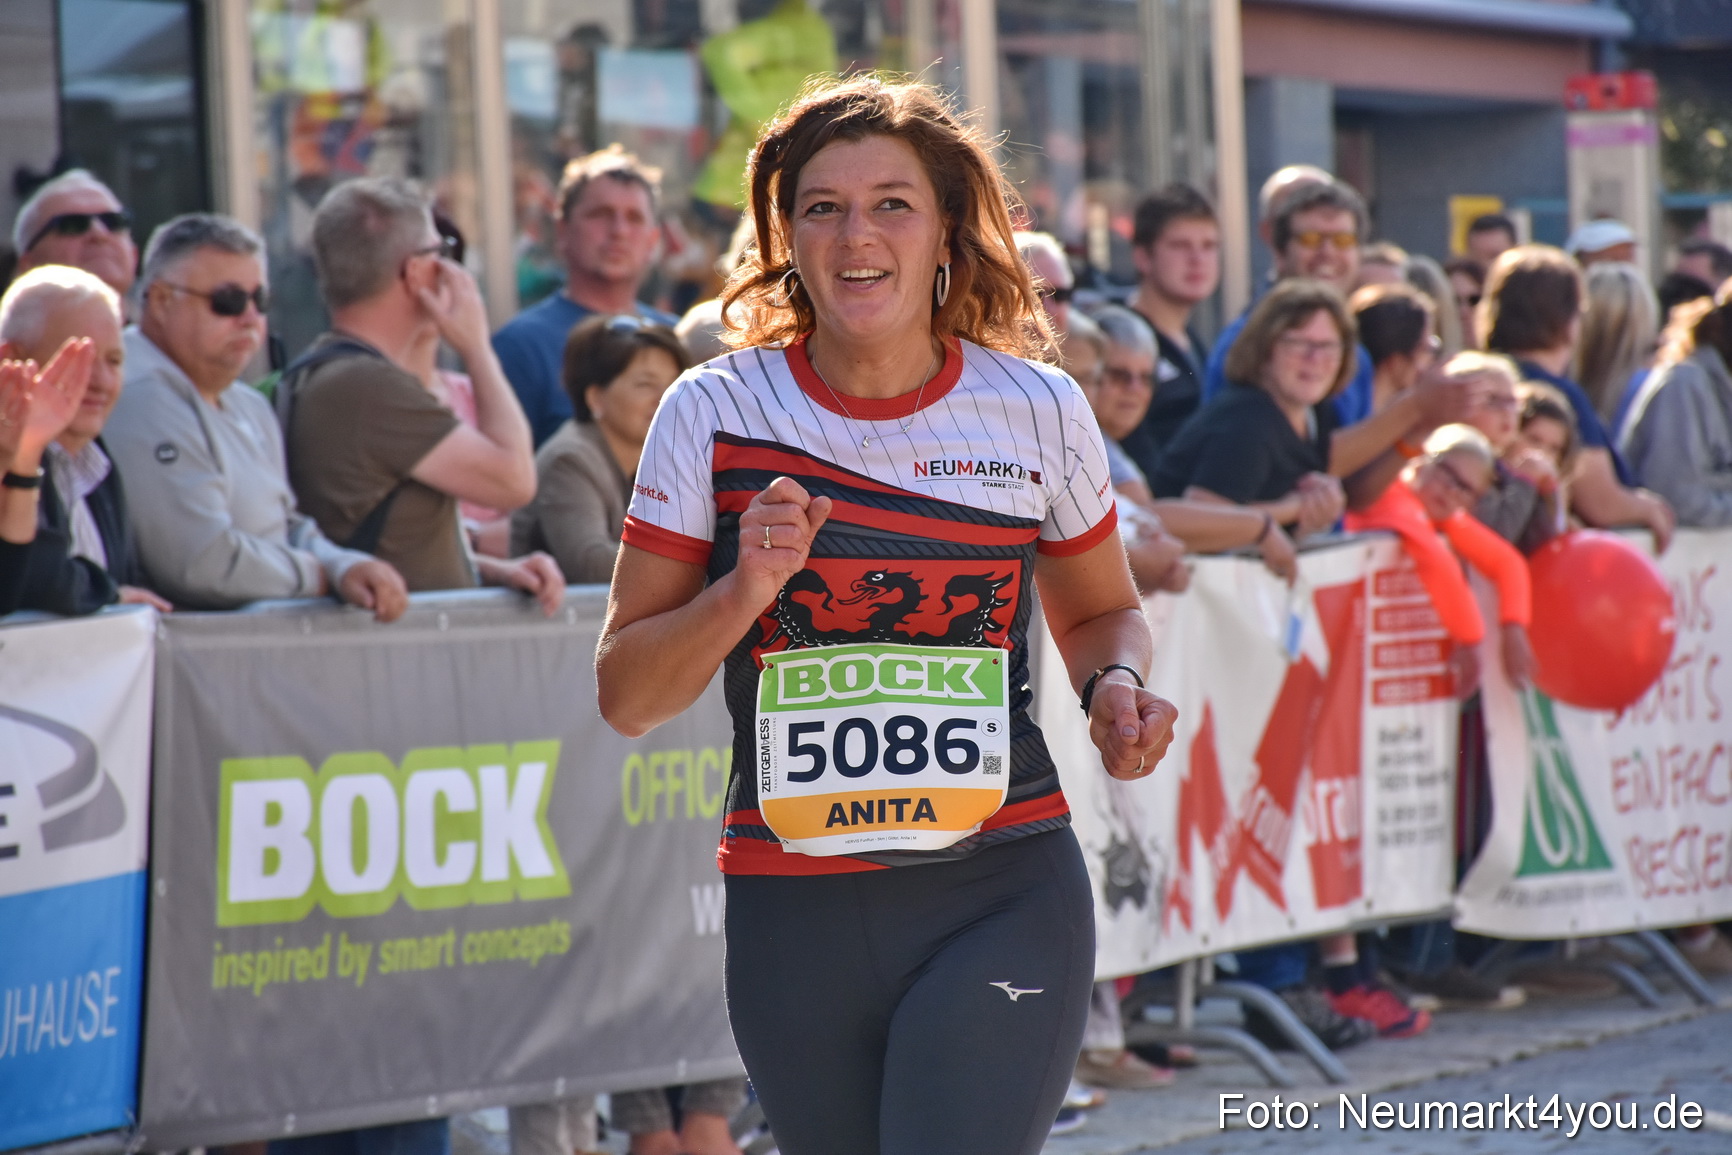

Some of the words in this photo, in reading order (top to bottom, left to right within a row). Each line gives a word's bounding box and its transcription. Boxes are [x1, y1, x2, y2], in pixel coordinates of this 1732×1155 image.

[914, 460, 1023, 480] NEUMARKT
[982, 481, 1007, 489] STARKE
[1008, 482, 1025, 491] STADT
[780, 655, 983, 702] BOCK
[986, 722, 997, 733] S
[787, 714, 981, 783] 5086
[228, 760, 556, 904] BOCK
[825, 797, 938, 829] ANITA
[212, 932, 332, 997] inspired
[337, 931, 373, 988] by
[378, 926, 456, 975] smart
[462, 917, 572, 968] concepts
